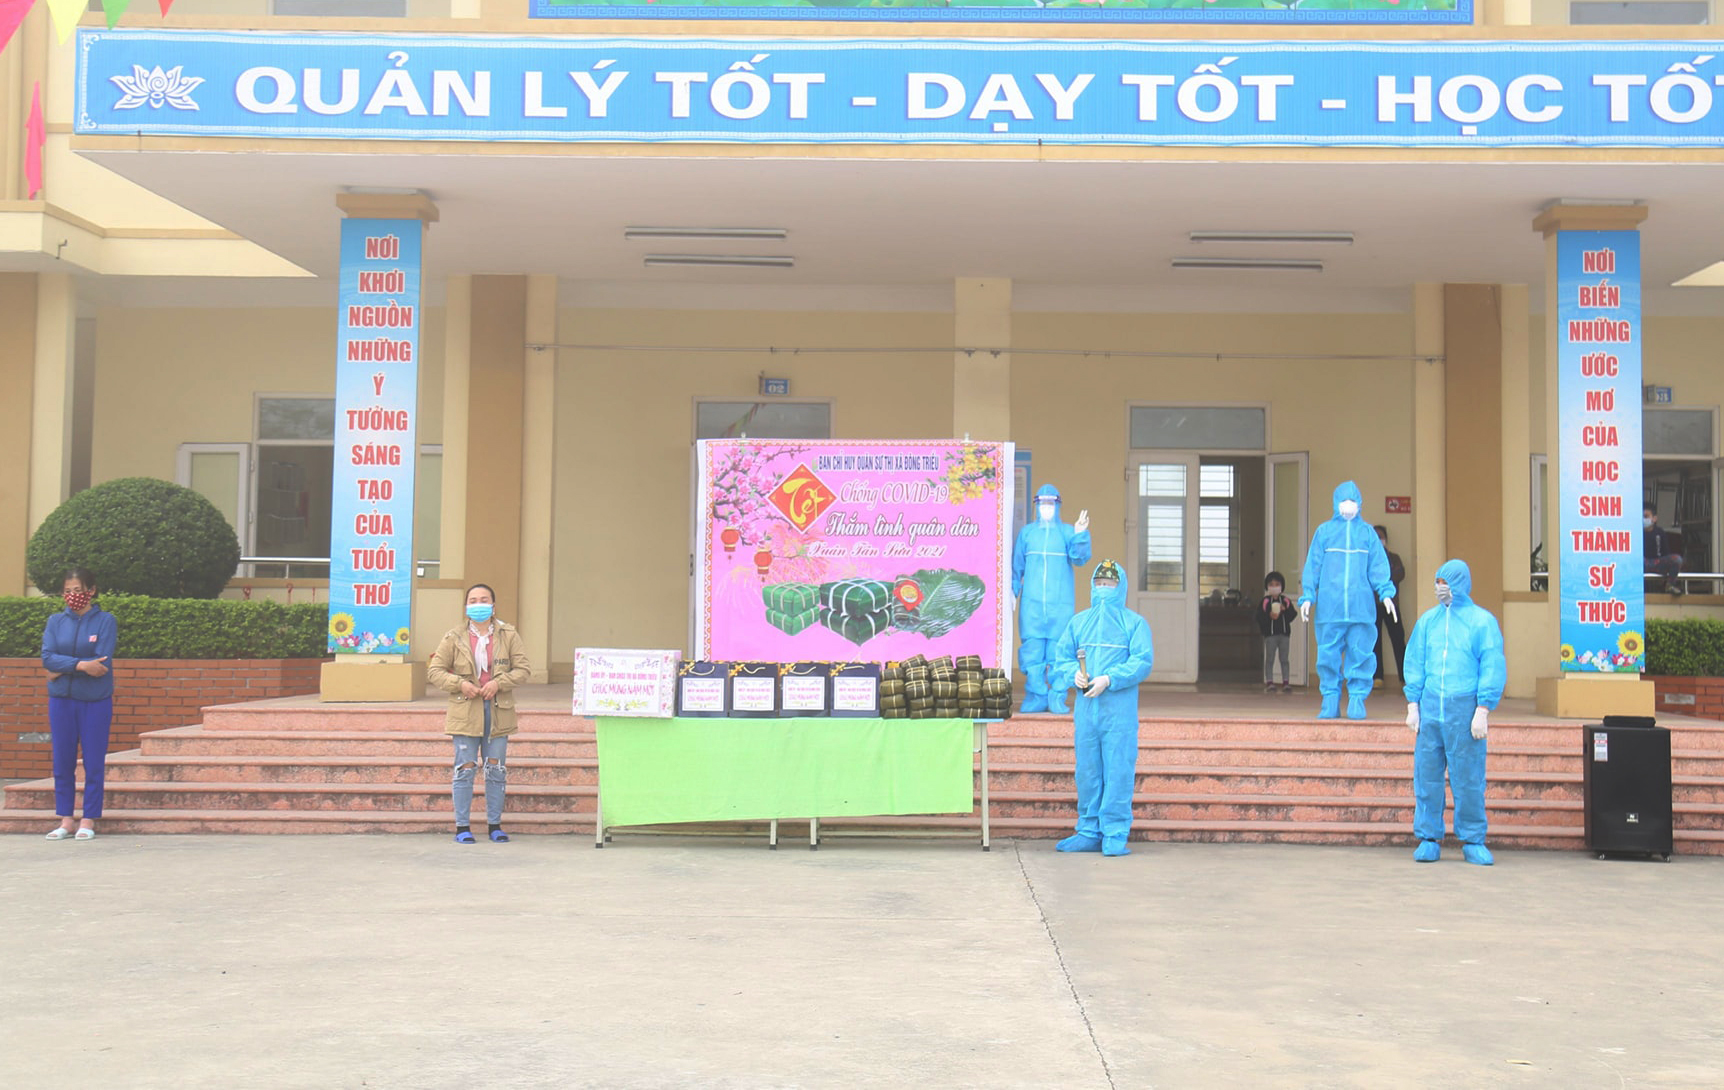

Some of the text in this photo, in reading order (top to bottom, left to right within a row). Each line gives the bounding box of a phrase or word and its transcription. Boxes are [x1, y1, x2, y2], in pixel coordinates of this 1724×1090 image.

[235, 50, 491, 117] QUẢN
[524, 59, 630, 118] LÝ
[655, 54, 826, 119] TỐT
[907, 72, 1096, 132] DẠY
[1123, 57, 1294, 122] TỐT
[1378, 75, 1564, 135] HỌC
[1592, 54, 1724, 124] TỐ
[366, 235, 398, 258] NƠI
[1584, 248, 1615, 272] NƠI
[1579, 279, 1619, 306] BIẾN
[349, 300, 412, 327] NGUỒN
[1569, 318, 1630, 341] NHỮNG
[348, 338, 411, 361] NHỮNG
[1582, 353, 1618, 377] ƯỚC
[373, 373, 385, 396] Ý
[1586, 389, 1614, 411] MƠ
[347, 406, 408, 430] TƯỞNG
[1582, 421, 1618, 446] CỦA
[352, 442, 400, 465] SÁNG
[1582, 461, 1619, 485] HỌC
[358, 480, 392, 503] TẠO
[881, 483, 948, 504] COVID-19
[1580, 496, 1622, 516] SINH
[355, 510, 393, 535] CỦA
[908, 518, 946, 545] quân
[950, 515, 979, 537] dân
[1572, 528, 1630, 552] THÀNH
[352, 543, 394, 569] TUỔI
[1589, 564, 1615, 592] SỰ
[354, 582, 391, 605] THƠ
[1578, 599, 1626, 627] THỰC
